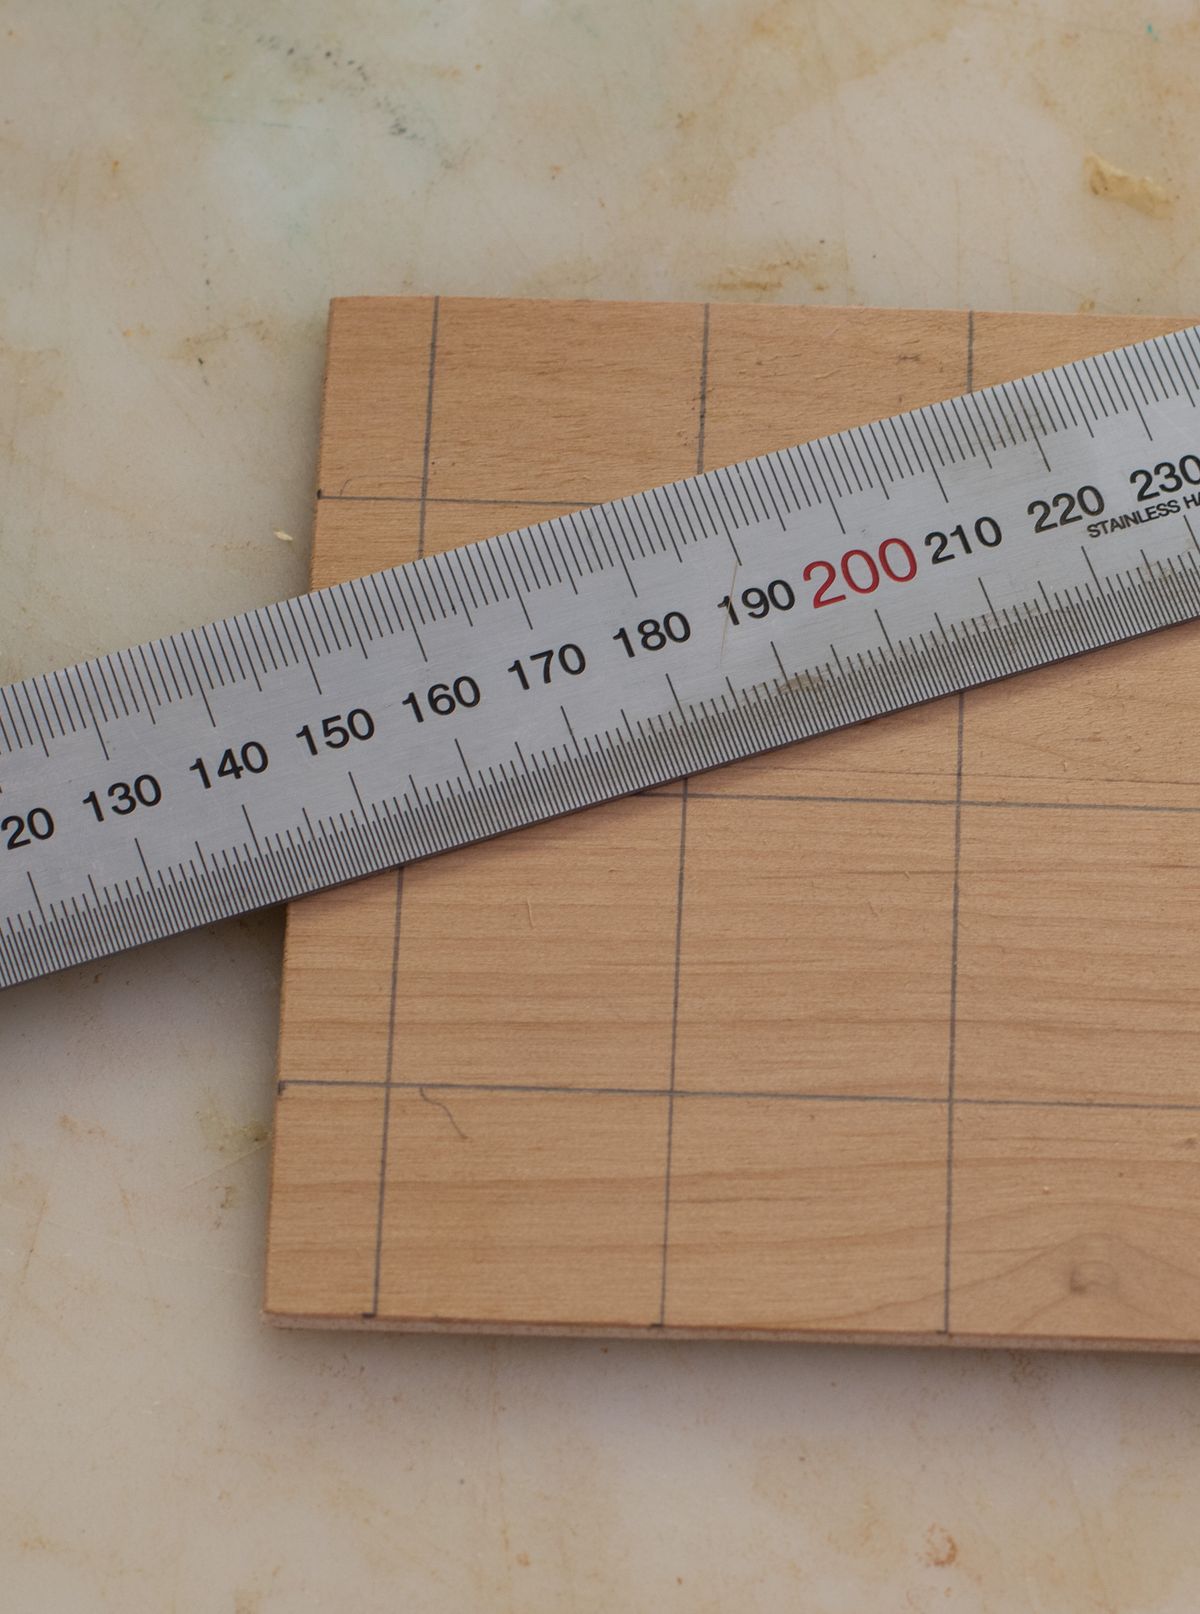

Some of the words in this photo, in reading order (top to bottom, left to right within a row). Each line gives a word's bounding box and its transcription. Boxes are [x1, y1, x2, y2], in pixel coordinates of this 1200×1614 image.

[1086, 499, 1181, 538] STAINLESS
[82, 774, 161, 822] 130
[189, 741, 268, 789] 140
[296, 709, 374, 756] 150
[402, 676, 480, 723] 160
[508, 644, 586, 690] 170
[613, 611, 691, 658] 180
[717, 580, 795, 625] 190
[803, 538, 917, 609] 200
[925, 516, 1002, 564] 210
[1027, 485, 1106, 534] 220
